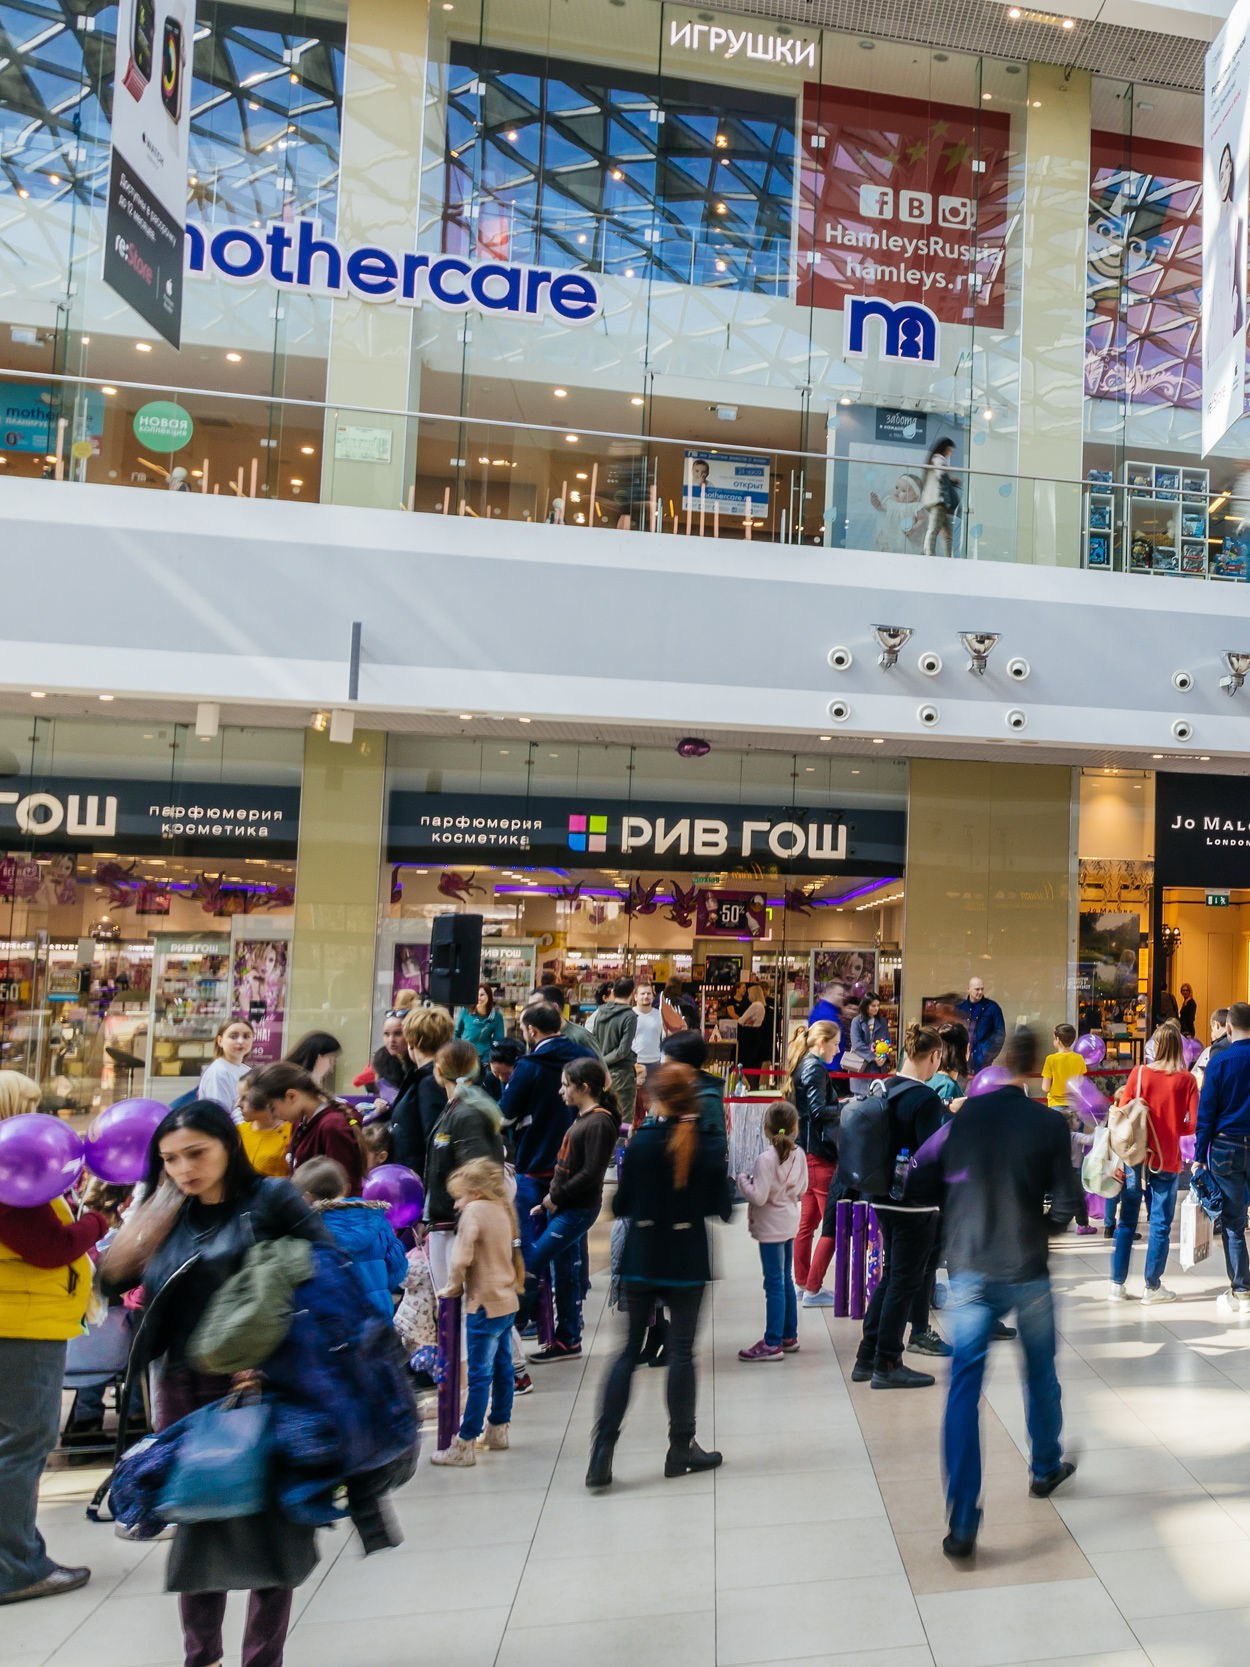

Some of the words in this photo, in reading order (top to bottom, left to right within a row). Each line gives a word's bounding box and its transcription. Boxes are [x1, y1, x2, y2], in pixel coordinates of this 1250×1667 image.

[670, 21, 815, 68] ИГРУШКИ
[150, 804, 283, 822] парфюмерия
[161, 823, 268, 838] косметика
[420, 816, 542, 832] парфюмерия
[432, 832, 530, 846] косметика
[621, 816, 729, 856] РИВ
[742, 820, 848, 860] ГОШ
